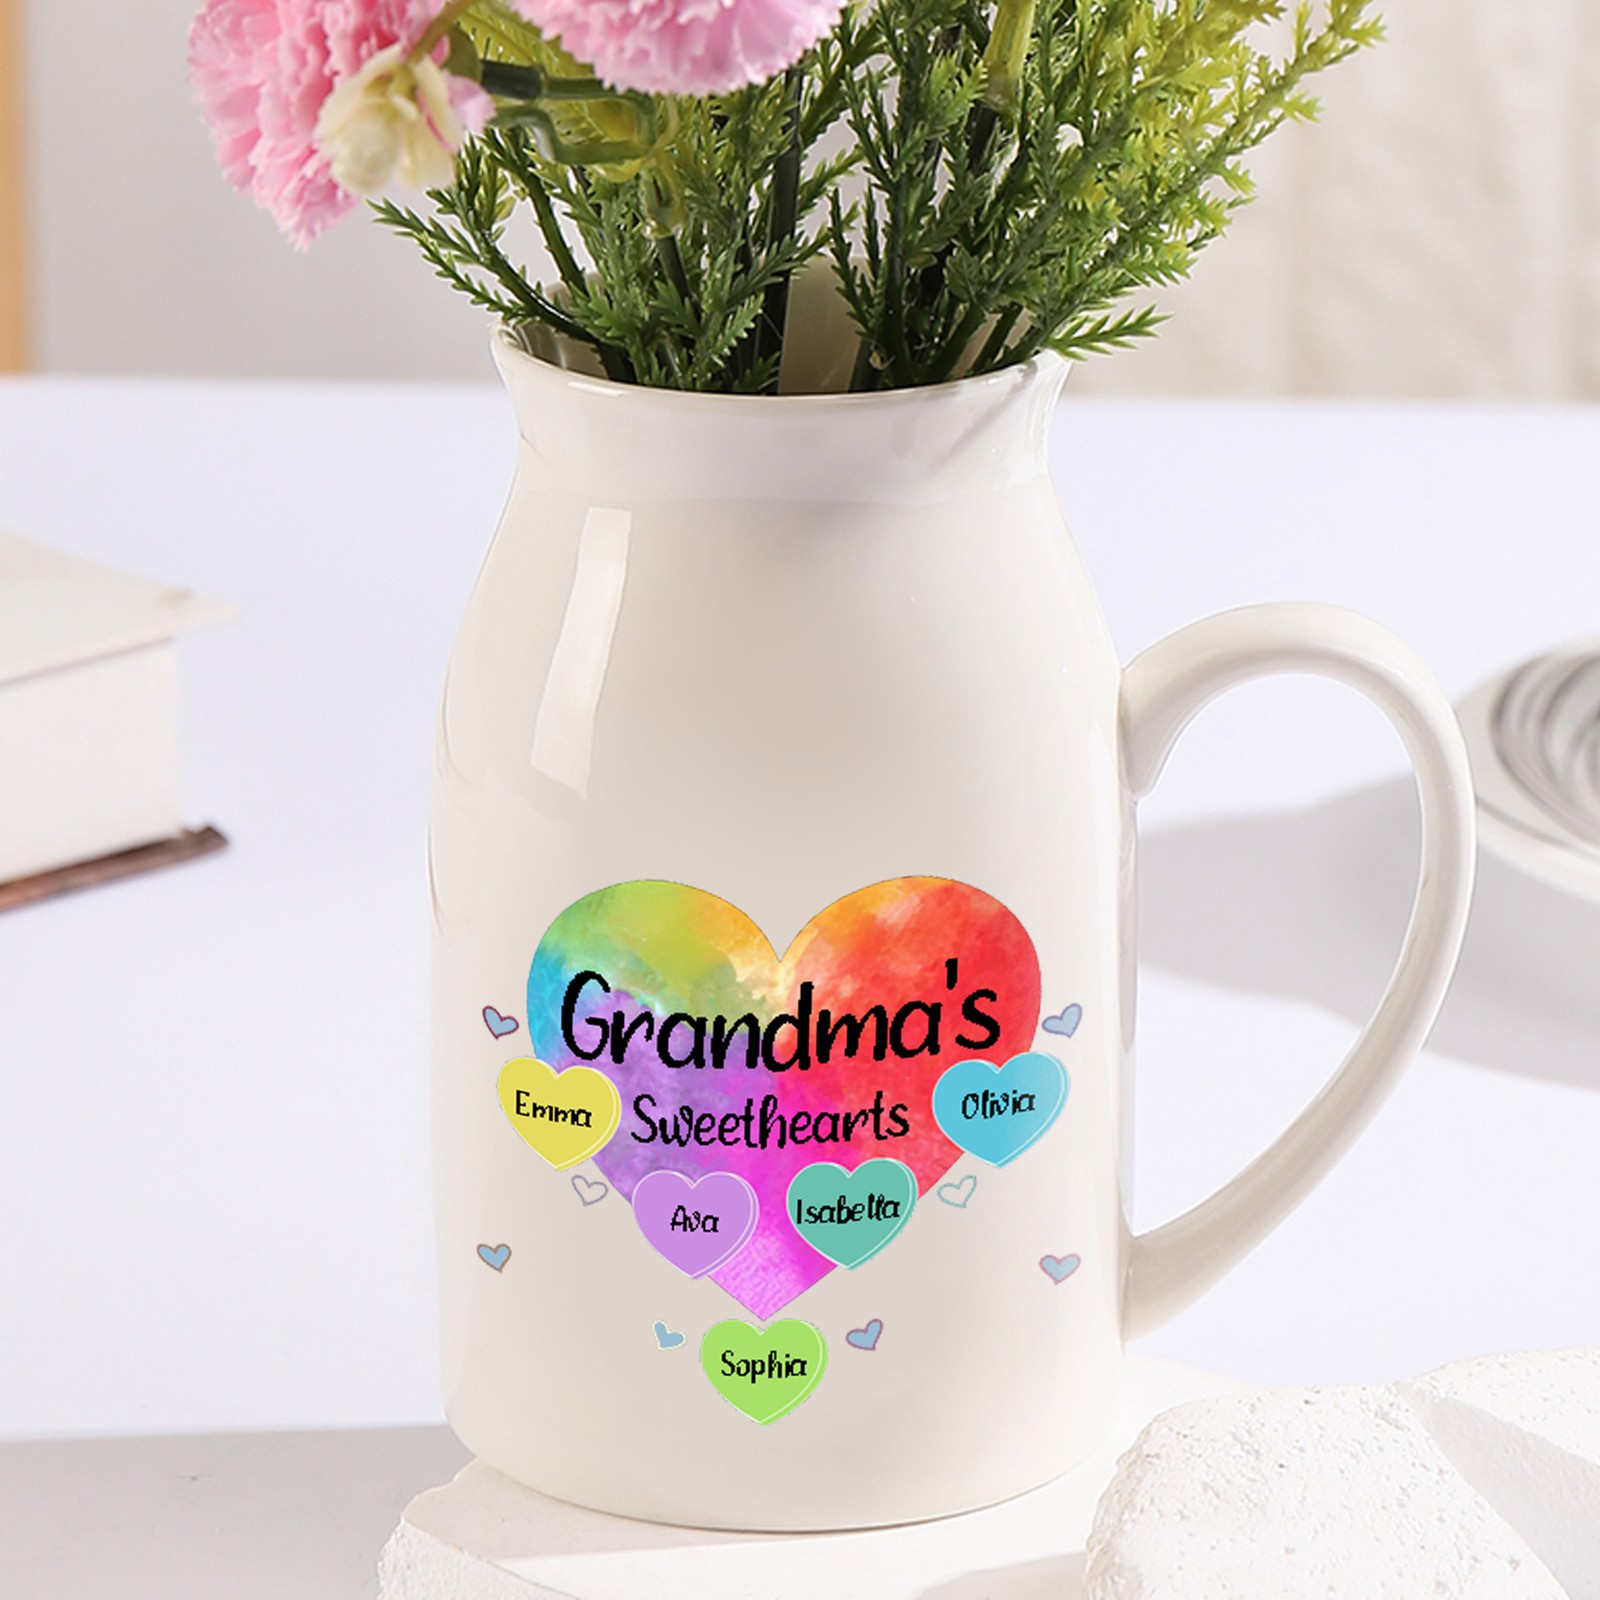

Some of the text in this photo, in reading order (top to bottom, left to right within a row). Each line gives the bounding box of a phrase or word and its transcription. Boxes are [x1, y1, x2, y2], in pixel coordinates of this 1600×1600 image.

[561, 958, 1001, 1073] Grandma's
[515, 1090, 592, 1128] Emma
[631, 1091, 910, 1150] Sweethearts
[961, 1090, 1036, 1120] Olivia
[670, 1205, 719, 1234] Ava
[796, 1193, 901, 1225] Isabella
[721, 1350, 807, 1384] Sophia
